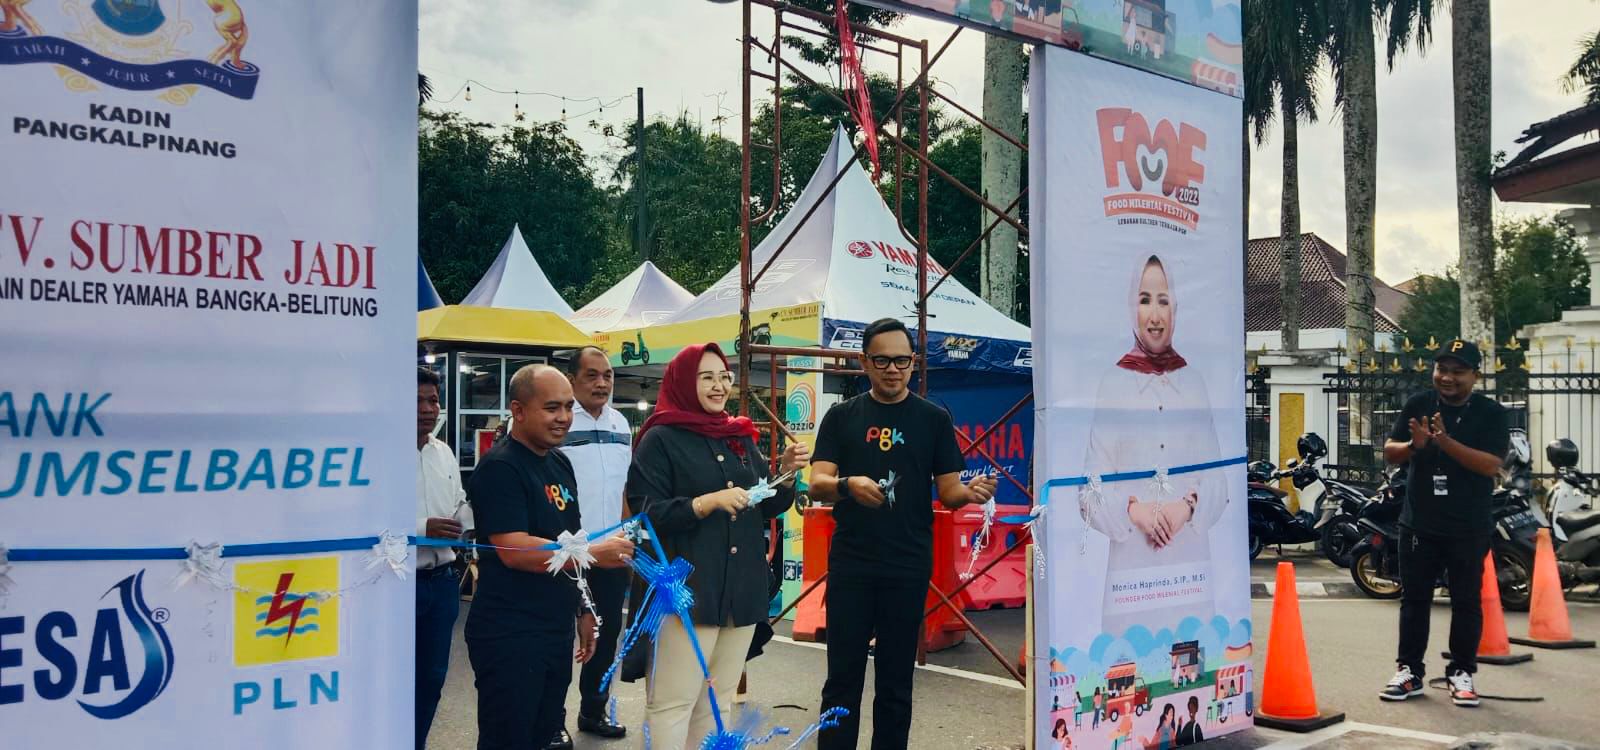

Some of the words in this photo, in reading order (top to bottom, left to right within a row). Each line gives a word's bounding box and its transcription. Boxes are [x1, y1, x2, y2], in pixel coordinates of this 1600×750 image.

[13, 42, 65, 57] TABAH
[106, 66, 151, 83] JUJUR
[193, 66, 233, 88] SETIA
[89, 103, 172, 129] KADIN
[13, 117, 237, 159] PANGKALPINANG
[1107, 198, 1128, 211] FOOD
[1163, 204, 1195, 224] FESTIVAL
[1179, 188, 1198, 204] 2022
[0, 213, 55, 269] V.
[70, 219, 264, 281] SUMBER
[284, 239, 377, 290] JADI
[30, 279, 107, 305] DEALER
[113, 283, 189, 309] YAMAHA
[196, 287, 378, 318] BANGKA-BELITUNG
[1450, 341, 1464, 353] P
[0, 391, 113, 438] ANK
[866, 426, 905, 451] pgk
[0, 447, 371, 498] UMSELBABEL
[1112, 583, 1137, 593] Monica
[1115, 595, 1140, 604] FOUNDER
[232, 671, 340, 715] PLN
